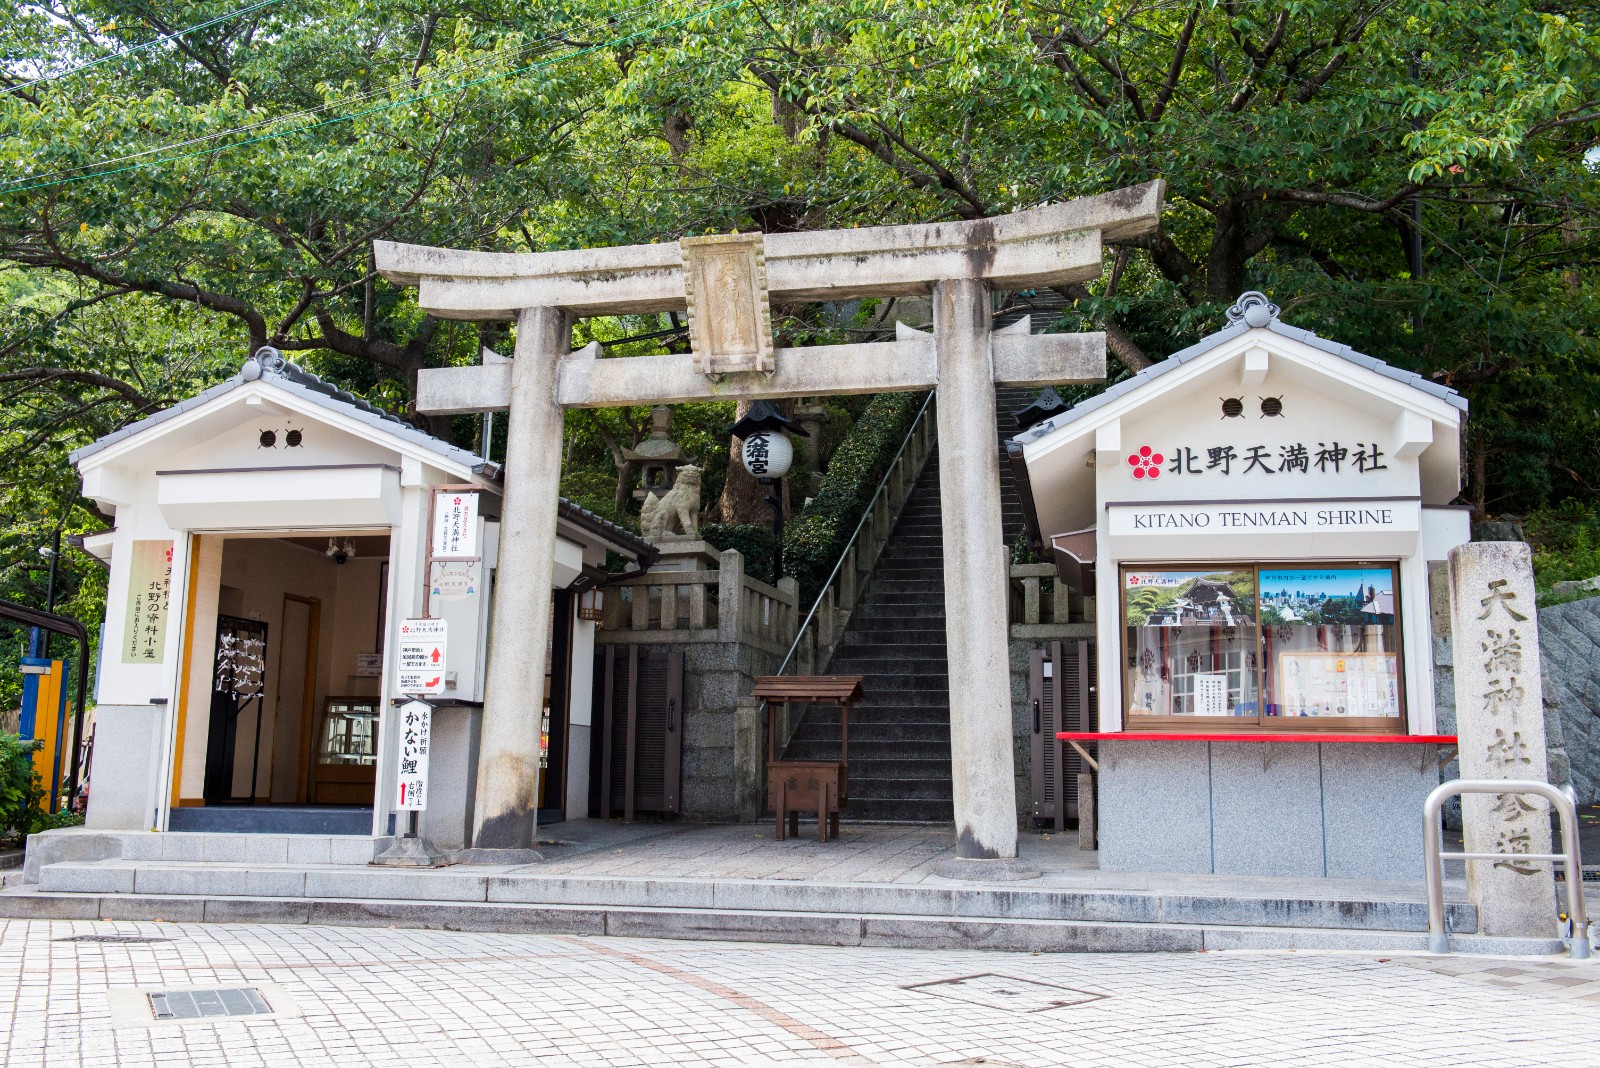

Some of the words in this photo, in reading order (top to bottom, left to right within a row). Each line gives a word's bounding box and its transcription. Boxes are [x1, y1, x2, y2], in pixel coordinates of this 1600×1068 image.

[746, 431, 770, 474] 天満宮
[1168, 441, 1388, 476] 北野天満神社
[451, 506, 461, 552] 北野天満神社
[1133, 512, 1210, 528] KITANO
[1219, 511, 1307, 527] TENMAN
[1317, 509, 1393, 526] SHRINE
[142, 581, 162, 659] 北野の資料小屋
[400, 711, 420, 775] かない鯉
[419, 711, 428, 755] 水かけ祈願
[1477, 578, 1542, 876] 天満神社参道
[407, 781, 415, 808] 右側です
[415, 780, 424, 806] 階段の上
